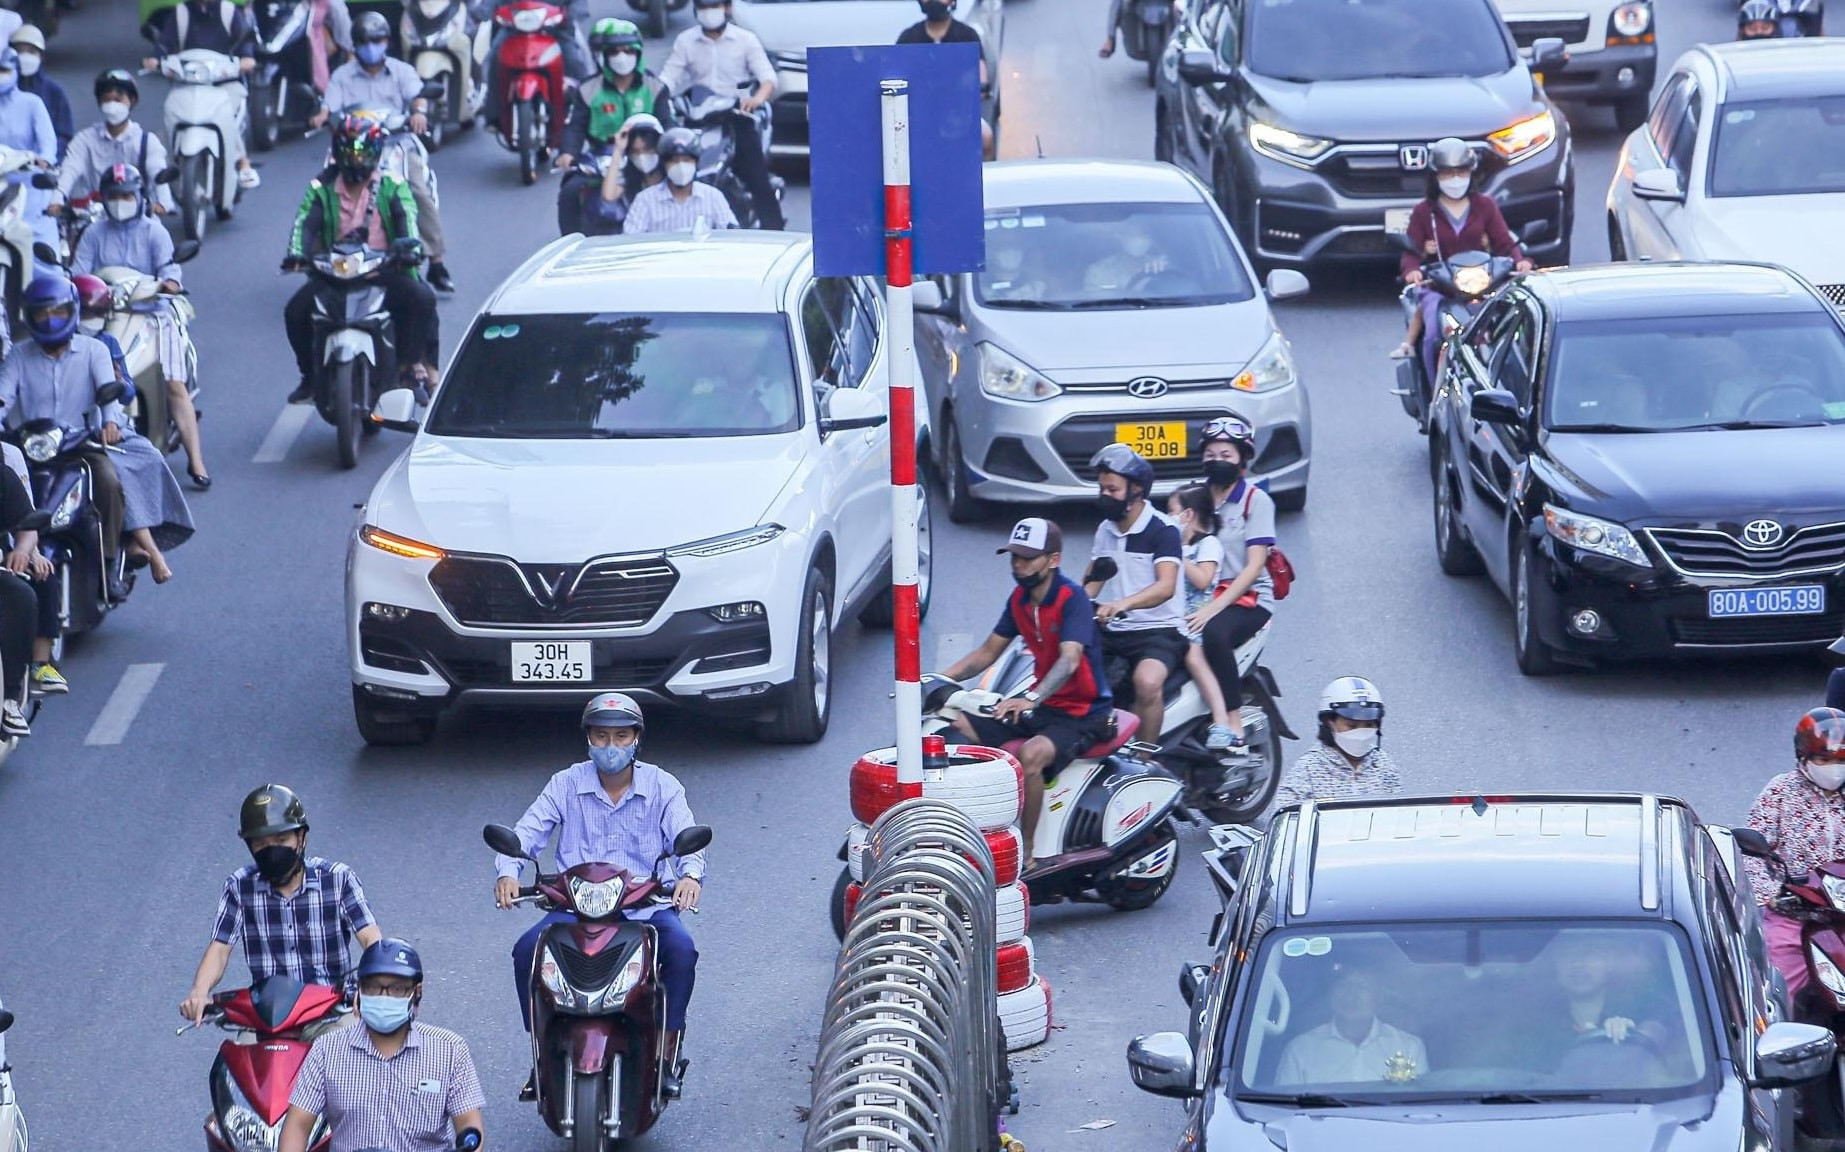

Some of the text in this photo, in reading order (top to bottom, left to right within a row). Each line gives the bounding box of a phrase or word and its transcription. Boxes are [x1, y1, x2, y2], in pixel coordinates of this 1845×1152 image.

[1136, 425, 1166, 441] 30A
[1712, 589, 1820, 614] 80A-005.99
[534, 644, 568, 660] 30H
[520, 663, 583, 680] 343.45
